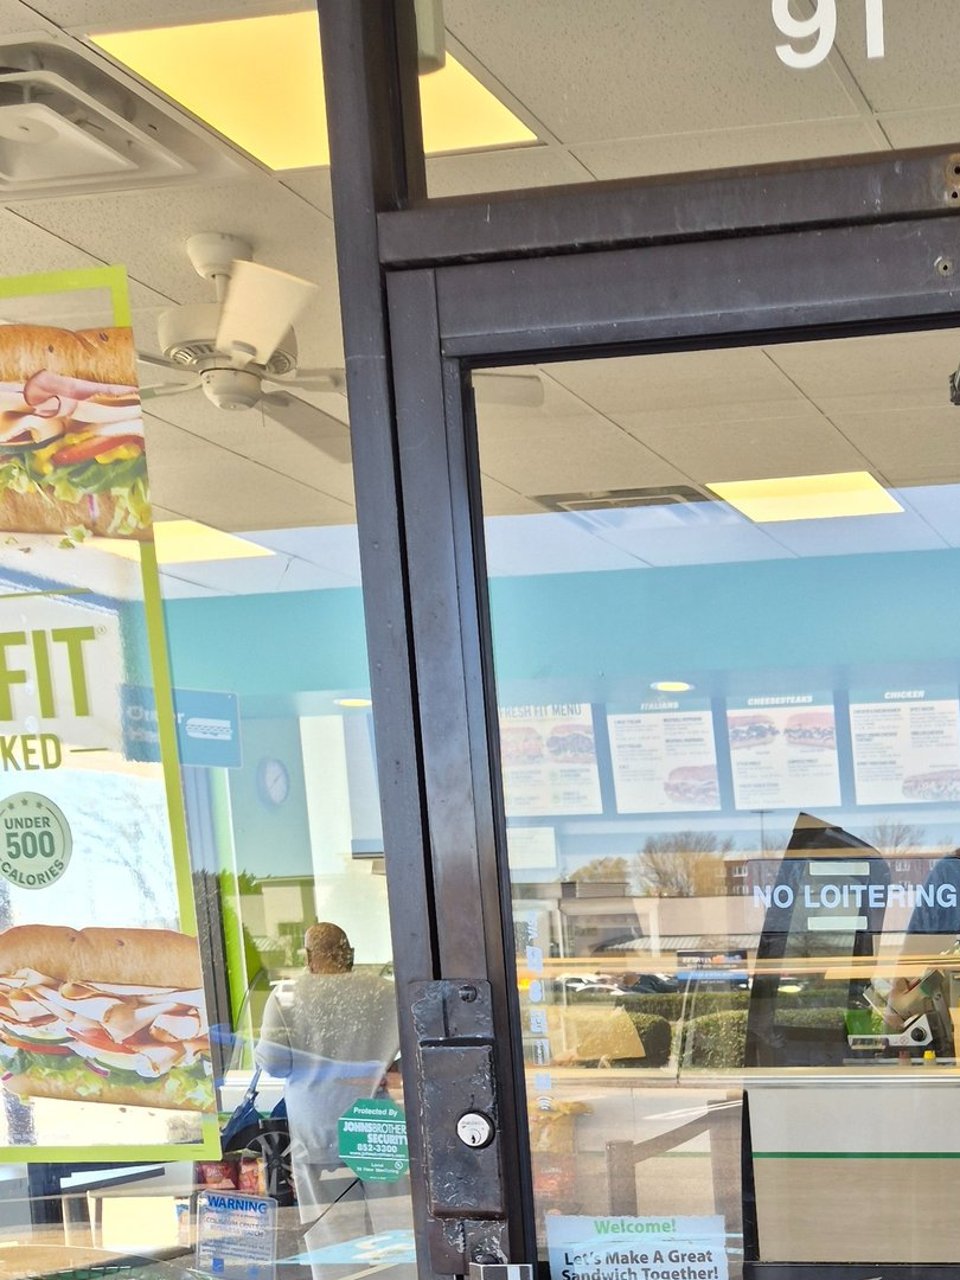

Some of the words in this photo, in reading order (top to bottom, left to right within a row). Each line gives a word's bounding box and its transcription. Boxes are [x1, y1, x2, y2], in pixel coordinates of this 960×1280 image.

[884, 690, 925, 699] CHICKEN
[4, 816, 51, 830] UNDER
[7, 831, 55, 859] 500
[1, 858, 64, 886] CALORIES
[753, 885, 794, 909] NO
[804, 883, 958, 909] LOITERING
[353, 1106, 387, 1115] Protected
[388, 1109, 398, 1117] By
[343, 1121, 407, 1135] JOHNSBROTHER
[207, 1196, 267, 1214] WARNING
[594, 1219, 677, 1234] Welcome!
[606, 1250, 649, 1264] Make
[653, 1250, 665, 1263] A
[668, 1250, 713, 1263] Great
